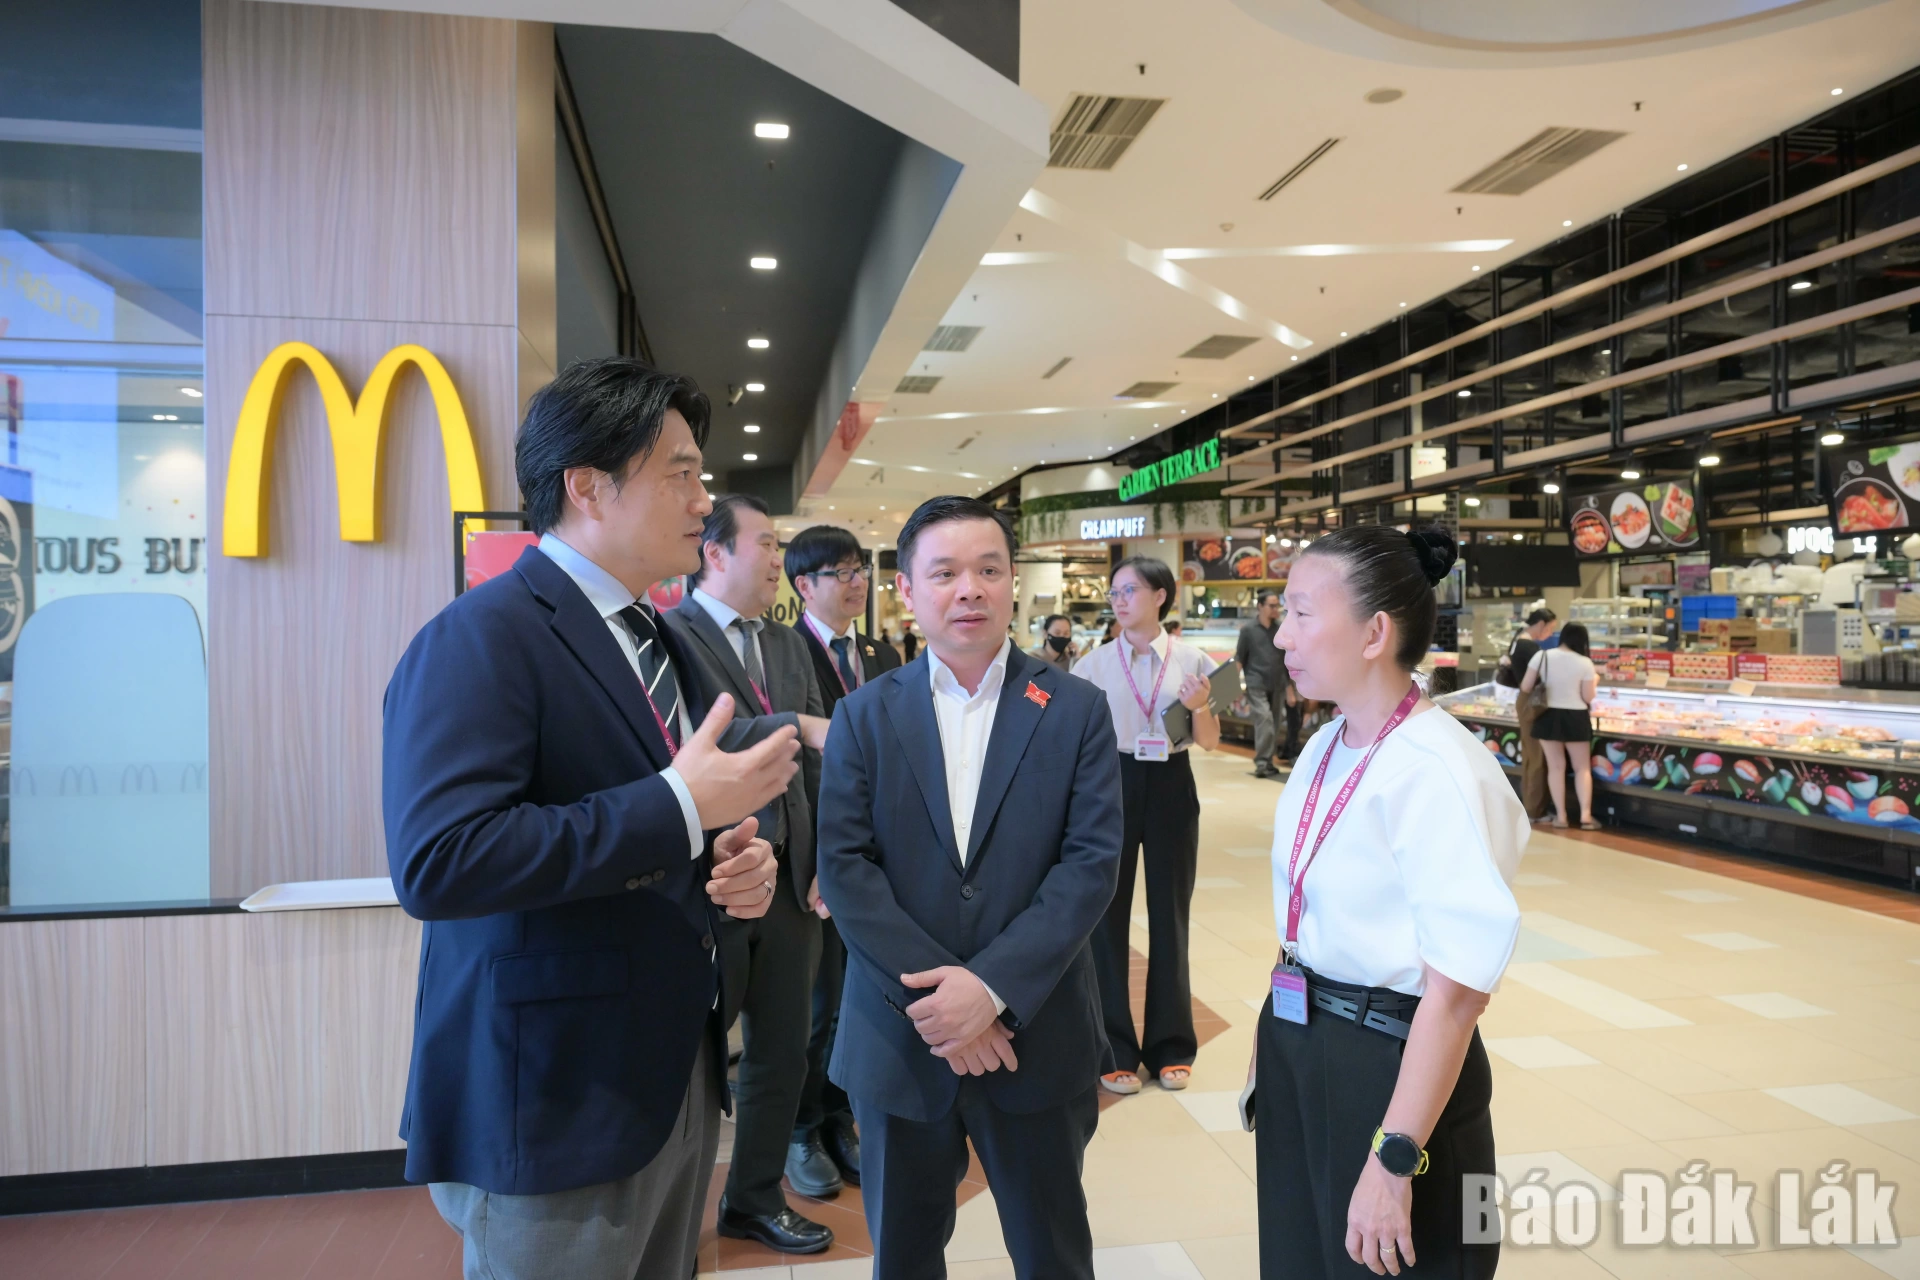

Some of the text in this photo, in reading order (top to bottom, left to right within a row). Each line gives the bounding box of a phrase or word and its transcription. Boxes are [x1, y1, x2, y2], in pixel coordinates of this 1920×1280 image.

[1119, 438, 1219, 501] GARDEN TERRACE
[144, 537, 206, 574] BU
[1787, 526, 1877, 554] NOOLE
[1296, 827, 1306, 845] NAM
[1302, 804, 1313, 823] BEST
[1308, 764, 1326, 804] COMPANIES
